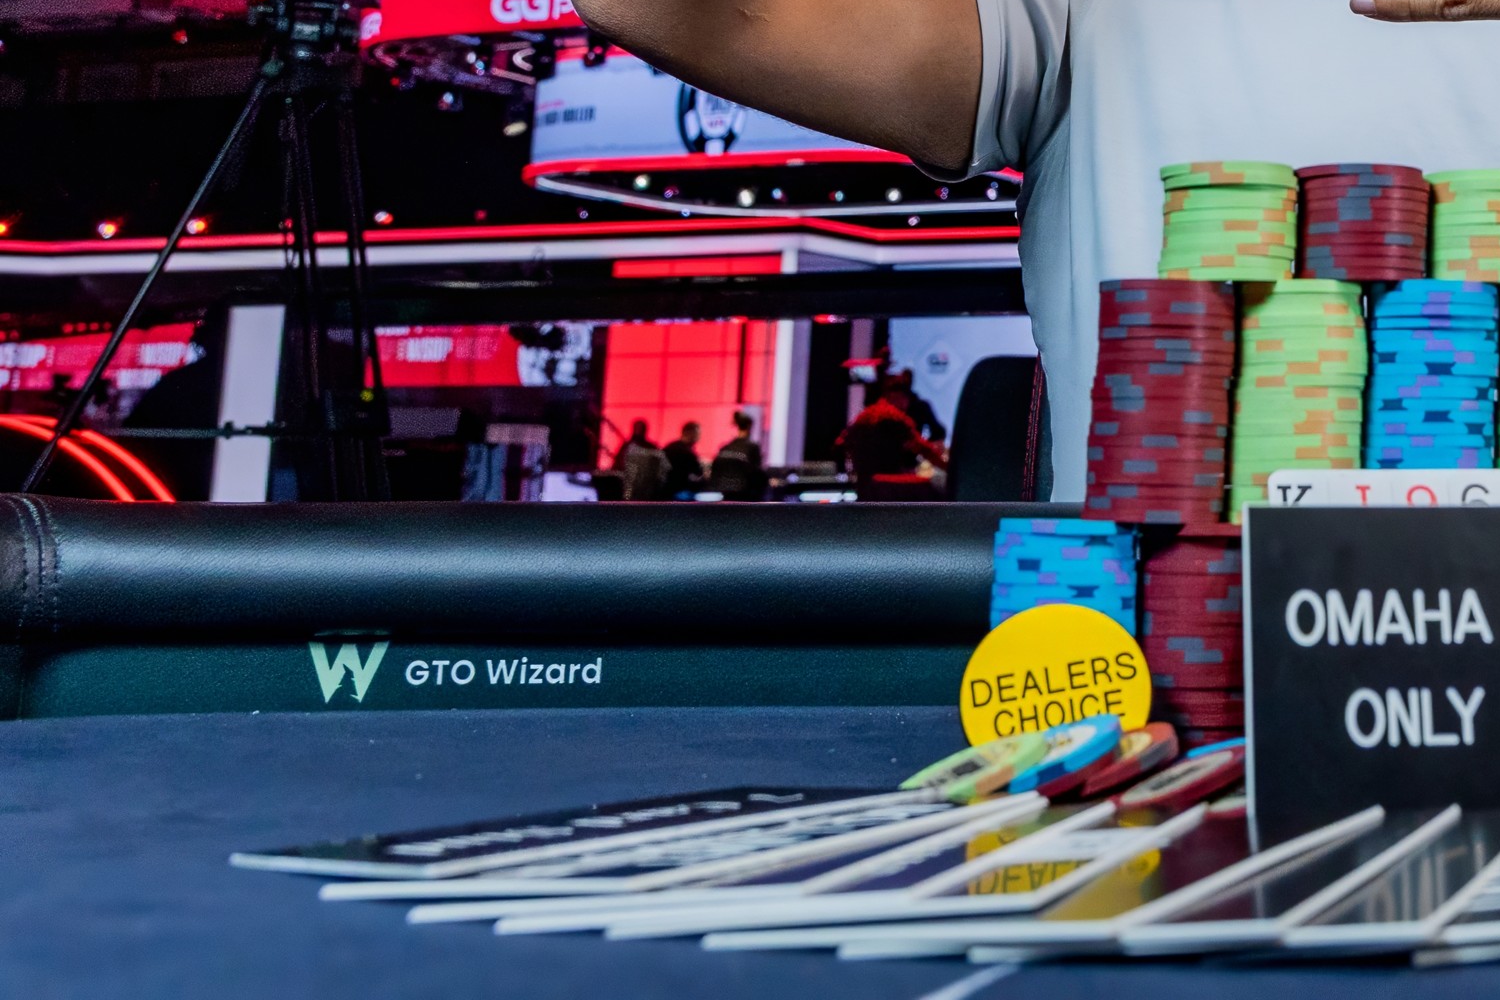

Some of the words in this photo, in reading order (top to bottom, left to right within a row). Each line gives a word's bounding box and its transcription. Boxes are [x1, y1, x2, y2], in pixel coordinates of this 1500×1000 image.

[1285, 588, 1494, 647] OMAHA
[405, 659, 476, 685] GTO
[486, 657, 602, 685] Wizard
[970, 652, 1137, 708] DEALERS
[994, 689, 1126, 737] CHOICE
[1344, 686, 1486, 748] ONLY
